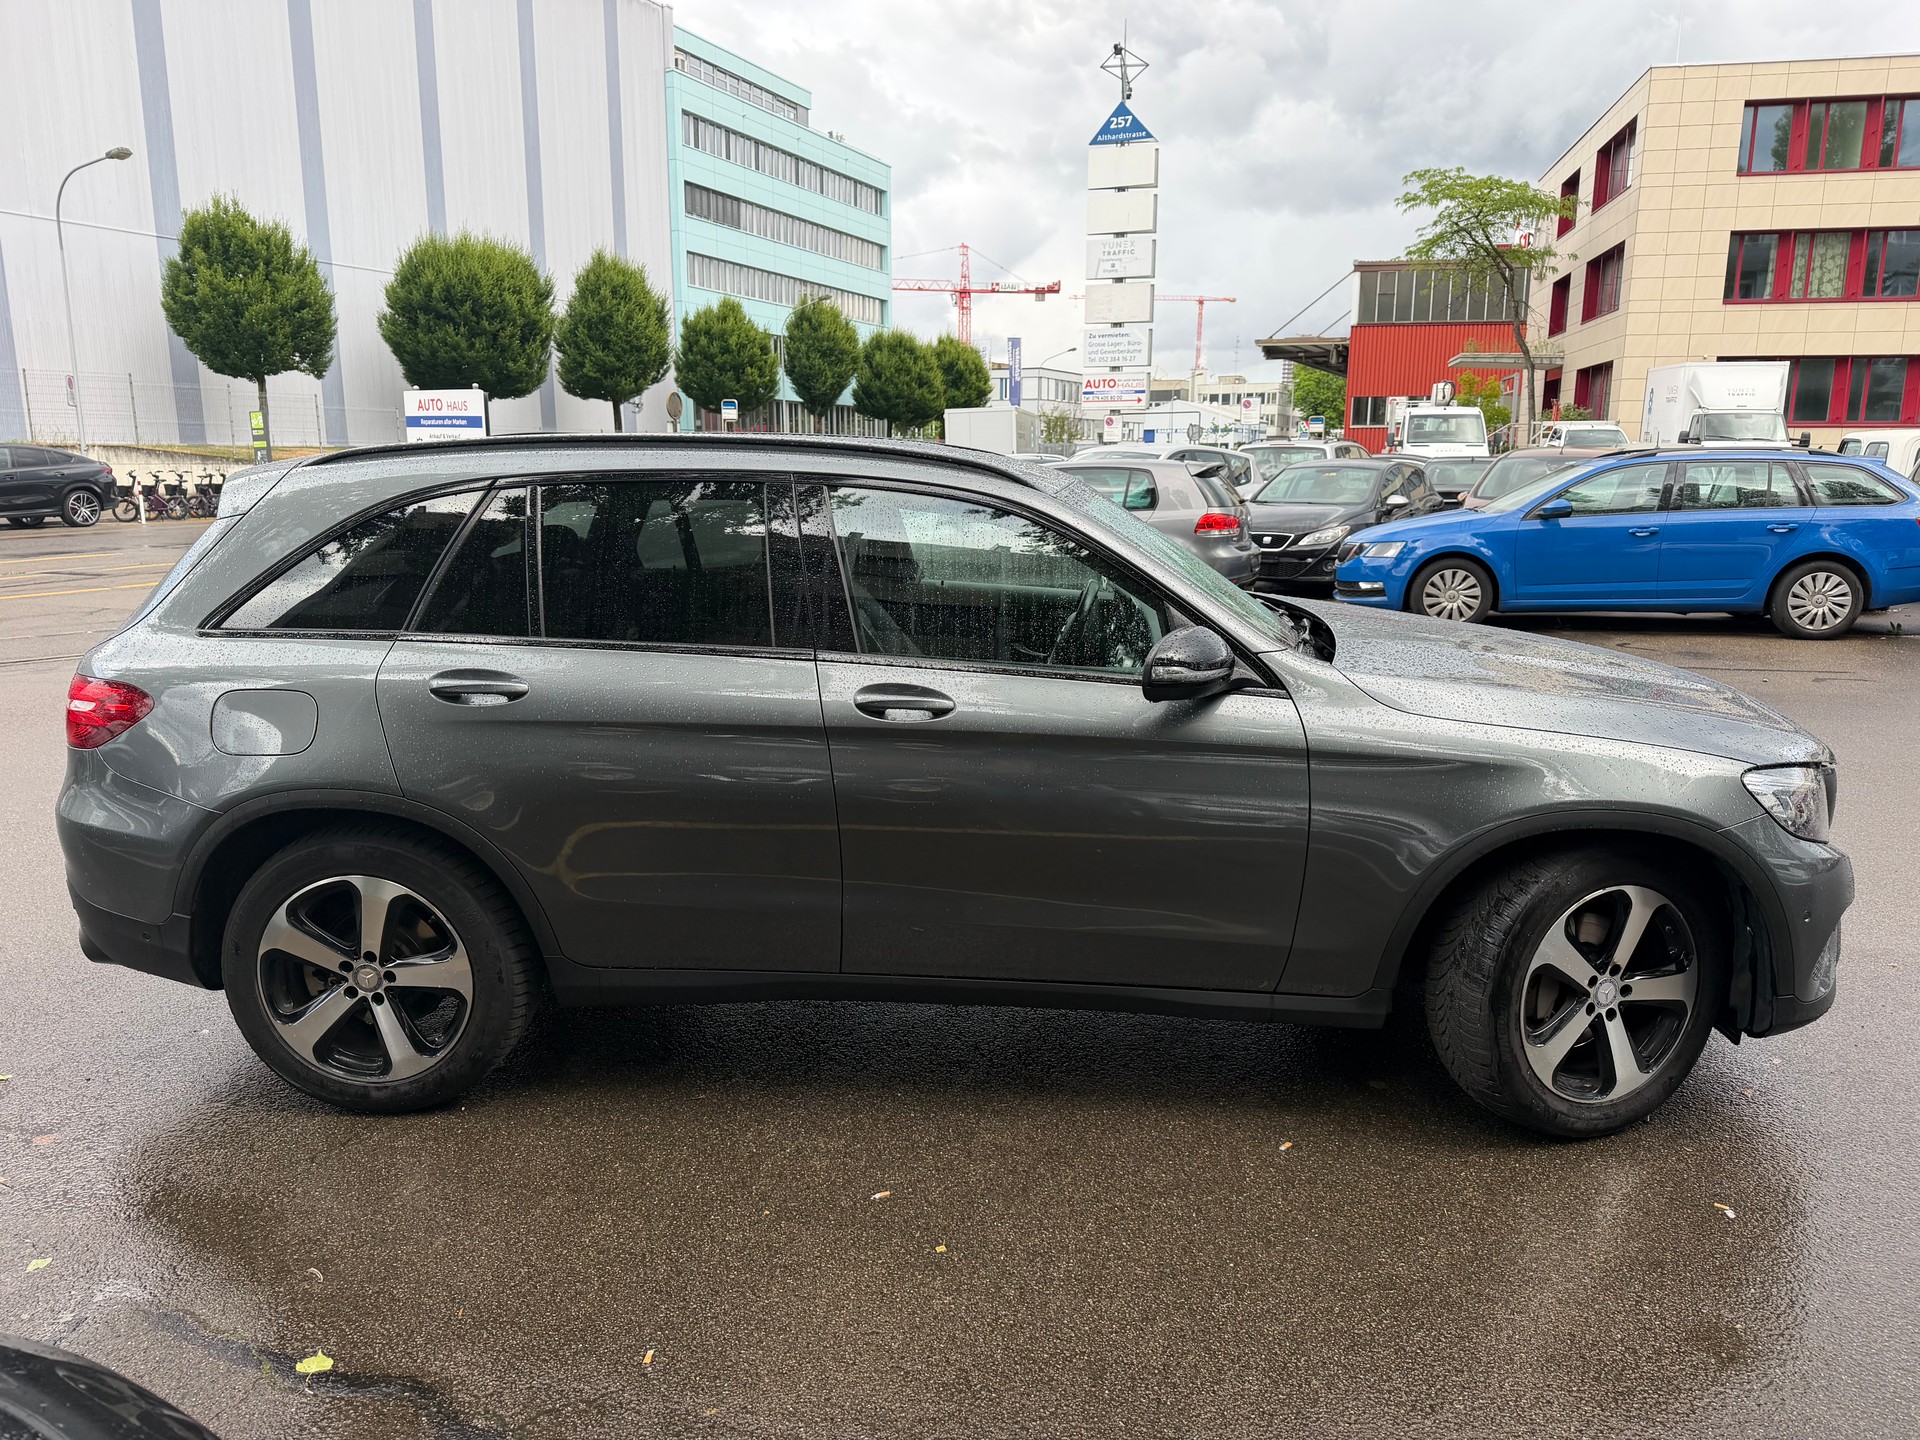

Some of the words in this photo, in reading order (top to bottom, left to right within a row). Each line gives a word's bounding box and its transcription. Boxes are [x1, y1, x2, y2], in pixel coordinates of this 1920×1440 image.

[1109, 115, 1133, 129] 257
[1097, 131, 1147, 141] Althardstrasse
[1101, 239, 1136, 249] YUNEX
[1100, 348, 1142, 356] Gewerberäume
[1085, 378, 1117, 389] AUTO
[417, 398, 443, 411] AUTO
[447, 400, 468, 411] HAUS
[420, 418, 443, 426] Reparaturen
